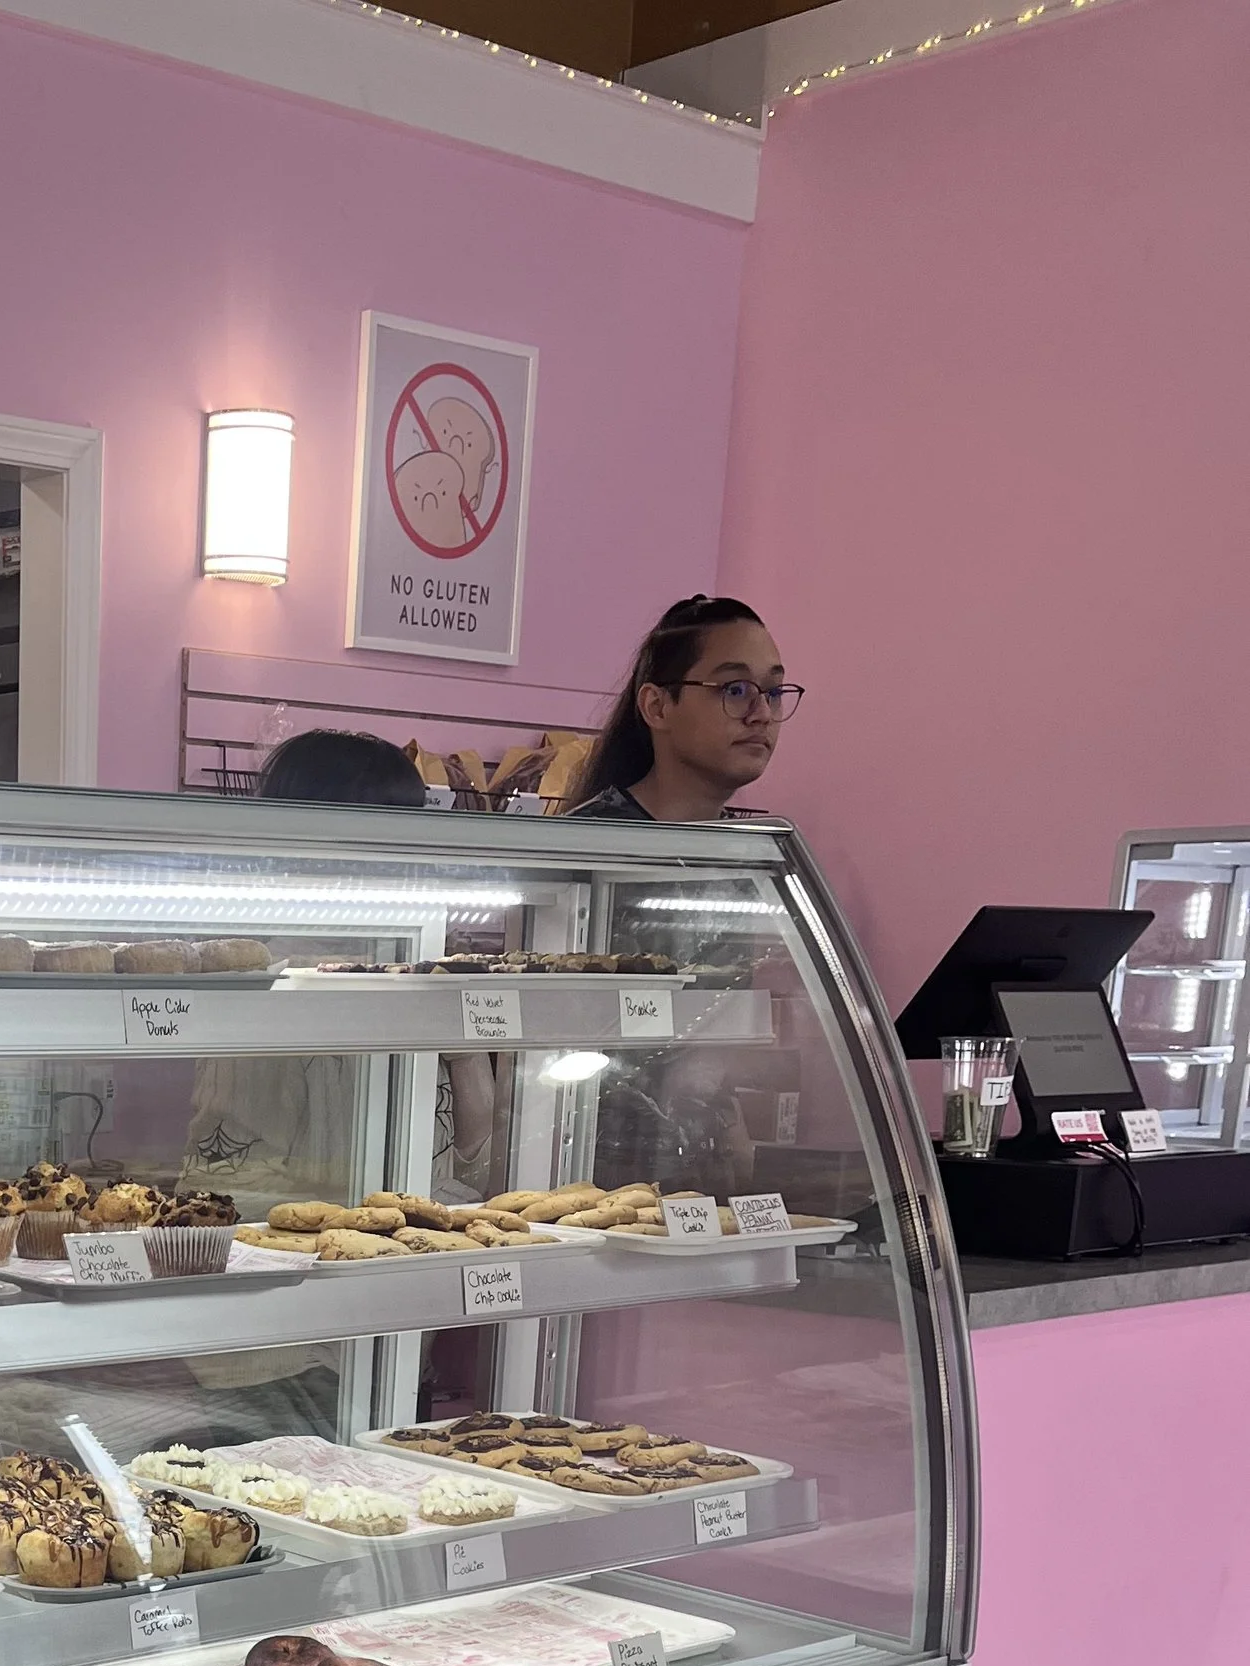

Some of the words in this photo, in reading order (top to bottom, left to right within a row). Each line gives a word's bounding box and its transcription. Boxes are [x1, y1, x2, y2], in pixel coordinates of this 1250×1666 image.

[390, 574, 414, 596] NO
[422, 578, 490, 606] GLUTEN
[398, 604, 478, 633] ALLOWED
[131, 996, 161, 1019] Apple
[164, 997, 191, 1015] Cider
[464, 992, 480, 1007] Red
[145, 1020, 179, 1037] Donuts
[669, 1206, 690, 1221] Triple
[690, 1206, 709, 1222] Chip
[72, 1240, 116, 1257] Jumbo
[78, 1257, 131, 1271] Chocolate
[79, 1269, 105, 1285] Chip
[467, 1267, 513, 1288] Chocolate
[696, 1498, 731, 1514] Chocolate
[700, 1512, 723, 1529] Peanut
[725, 1508, 748, 1521] Butter
[453, 1543, 467, 1560] Pie
[452, 1560, 485, 1576] Cookies
[134, 1604, 172, 1624] Caramel
[137, 1620, 170, 1636] Toffee
[171, 1612, 193, 1629] Rolls
[617, 1643, 643, 1661] Pizza
